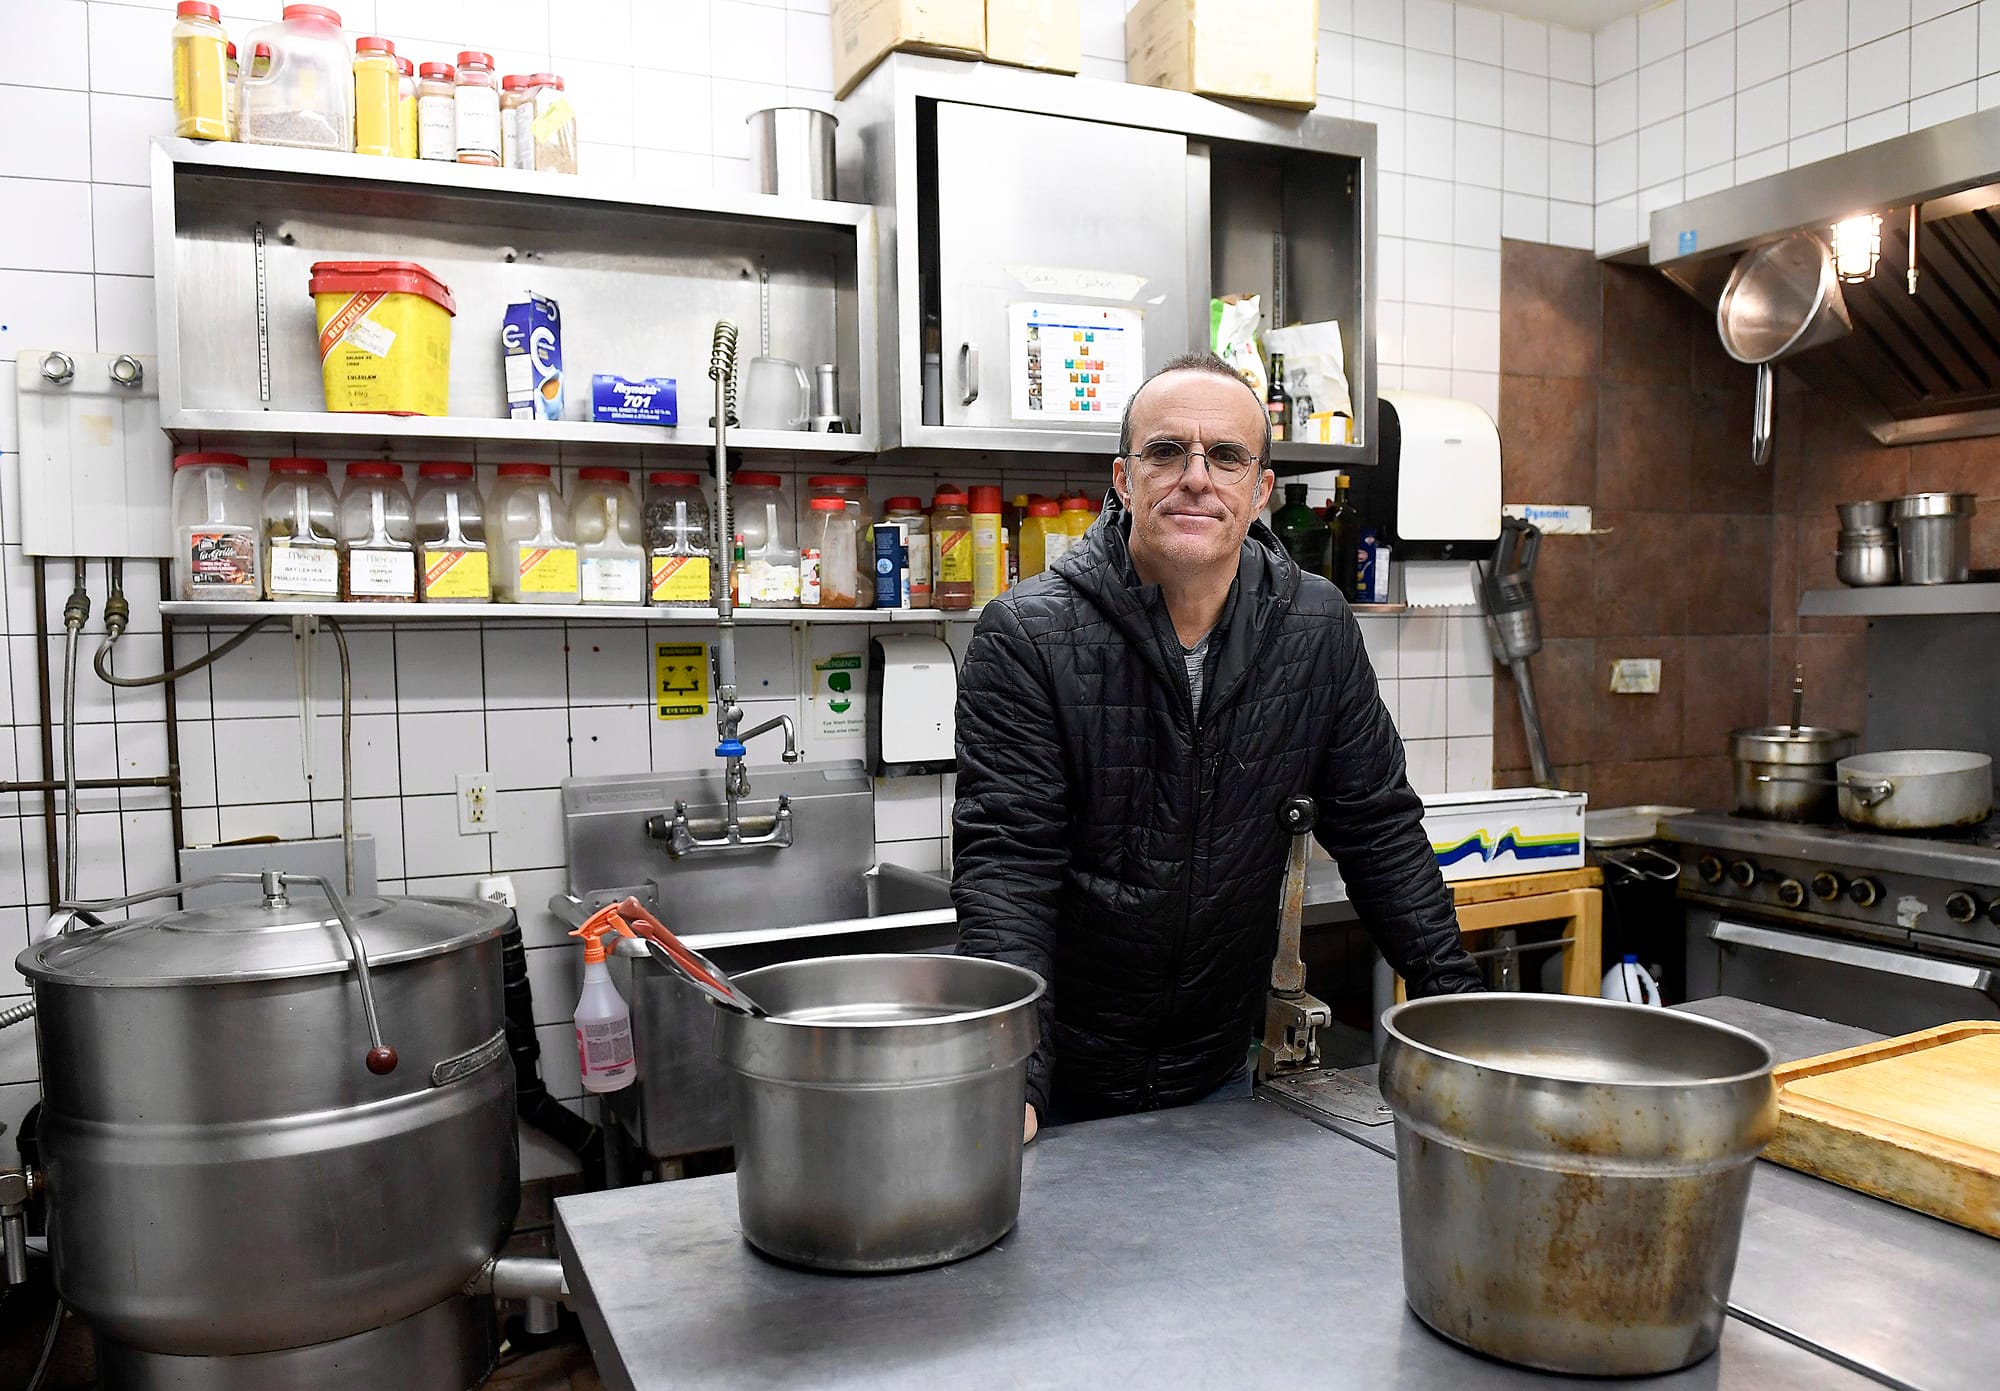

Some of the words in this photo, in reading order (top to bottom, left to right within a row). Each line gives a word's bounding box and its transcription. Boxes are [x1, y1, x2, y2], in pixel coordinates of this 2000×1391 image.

[327, 294, 371, 339] BERTHELET
[612, 382, 658, 396] Reynolds
[623, 395, 652, 409] 701
[1525, 506, 1569, 521] Dynamic
